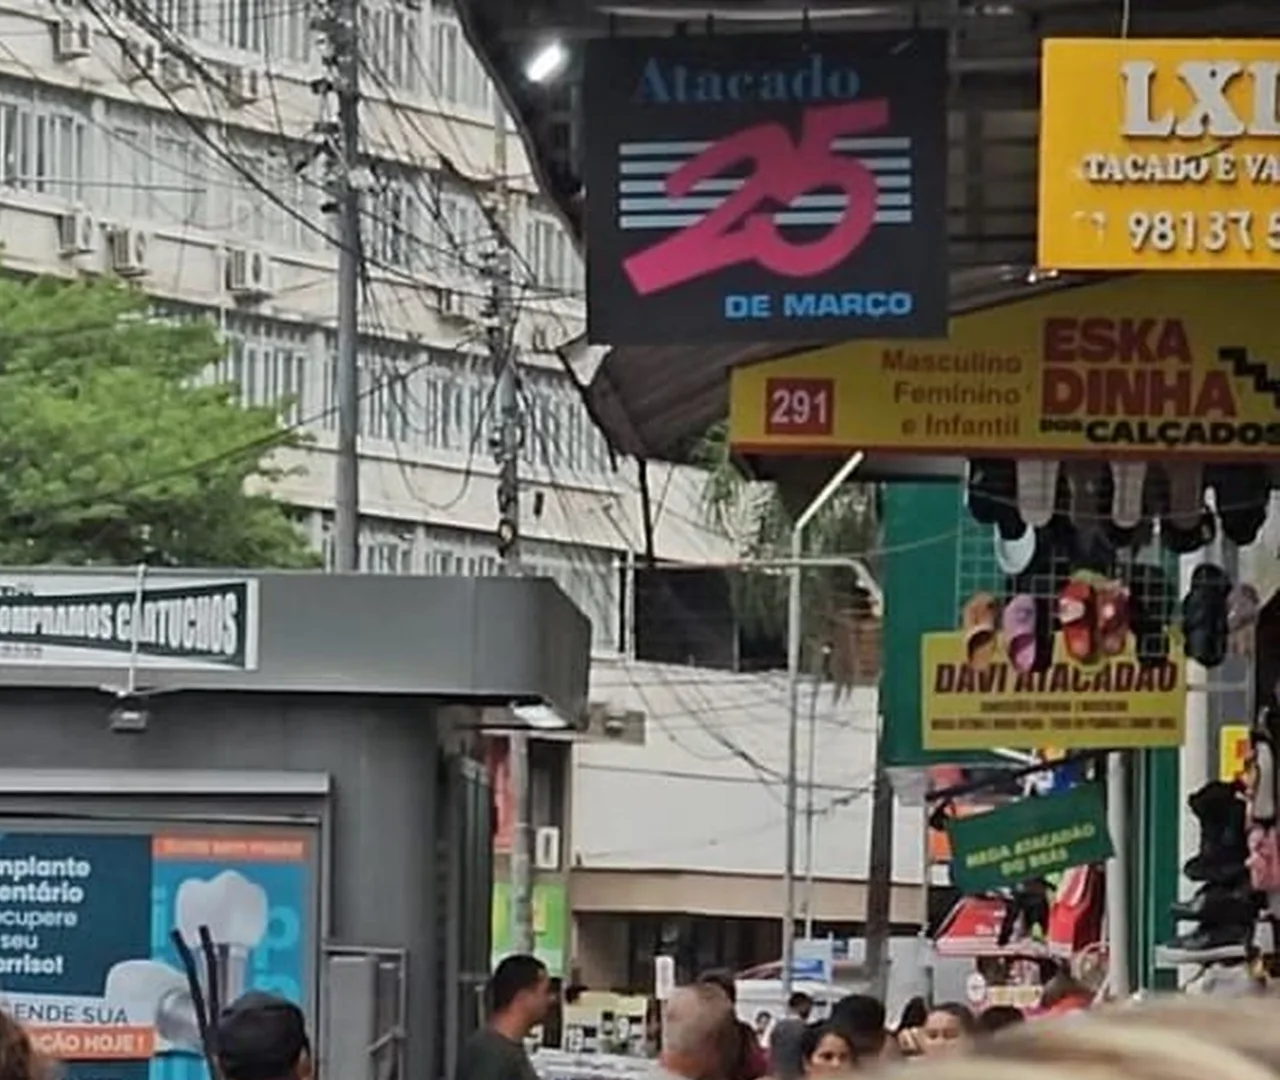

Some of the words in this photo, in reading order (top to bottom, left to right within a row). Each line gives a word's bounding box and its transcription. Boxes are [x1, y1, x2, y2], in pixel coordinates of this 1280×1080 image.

[633, 53, 861, 101] Atacado
[1081, 153, 1210, 183] TACADO
[1216, 153, 1237, 182] E
[621, 98, 889, 295] 25
[725, 295, 771, 318] DE
[783, 292, 912, 321] MARÇO
[1043, 318, 1193, 364] ESKA
[881, 349, 1023, 374] Masculino
[771, 390, 828, 425] 291
[893, 380, 1022, 406] Feminino
[1042, 367, 1238, 419] DINHA
[901, 420, 917, 437] e
[925, 416, 1020, 437] Infantil
[117, 592, 238, 656] CARTUCHOS
[934, 663, 1009, 694] DAVI
[0, 934, 39, 950] seu
[13, 1002, 80, 1024] ENDE
[82, 1005, 130, 1025] SUA
